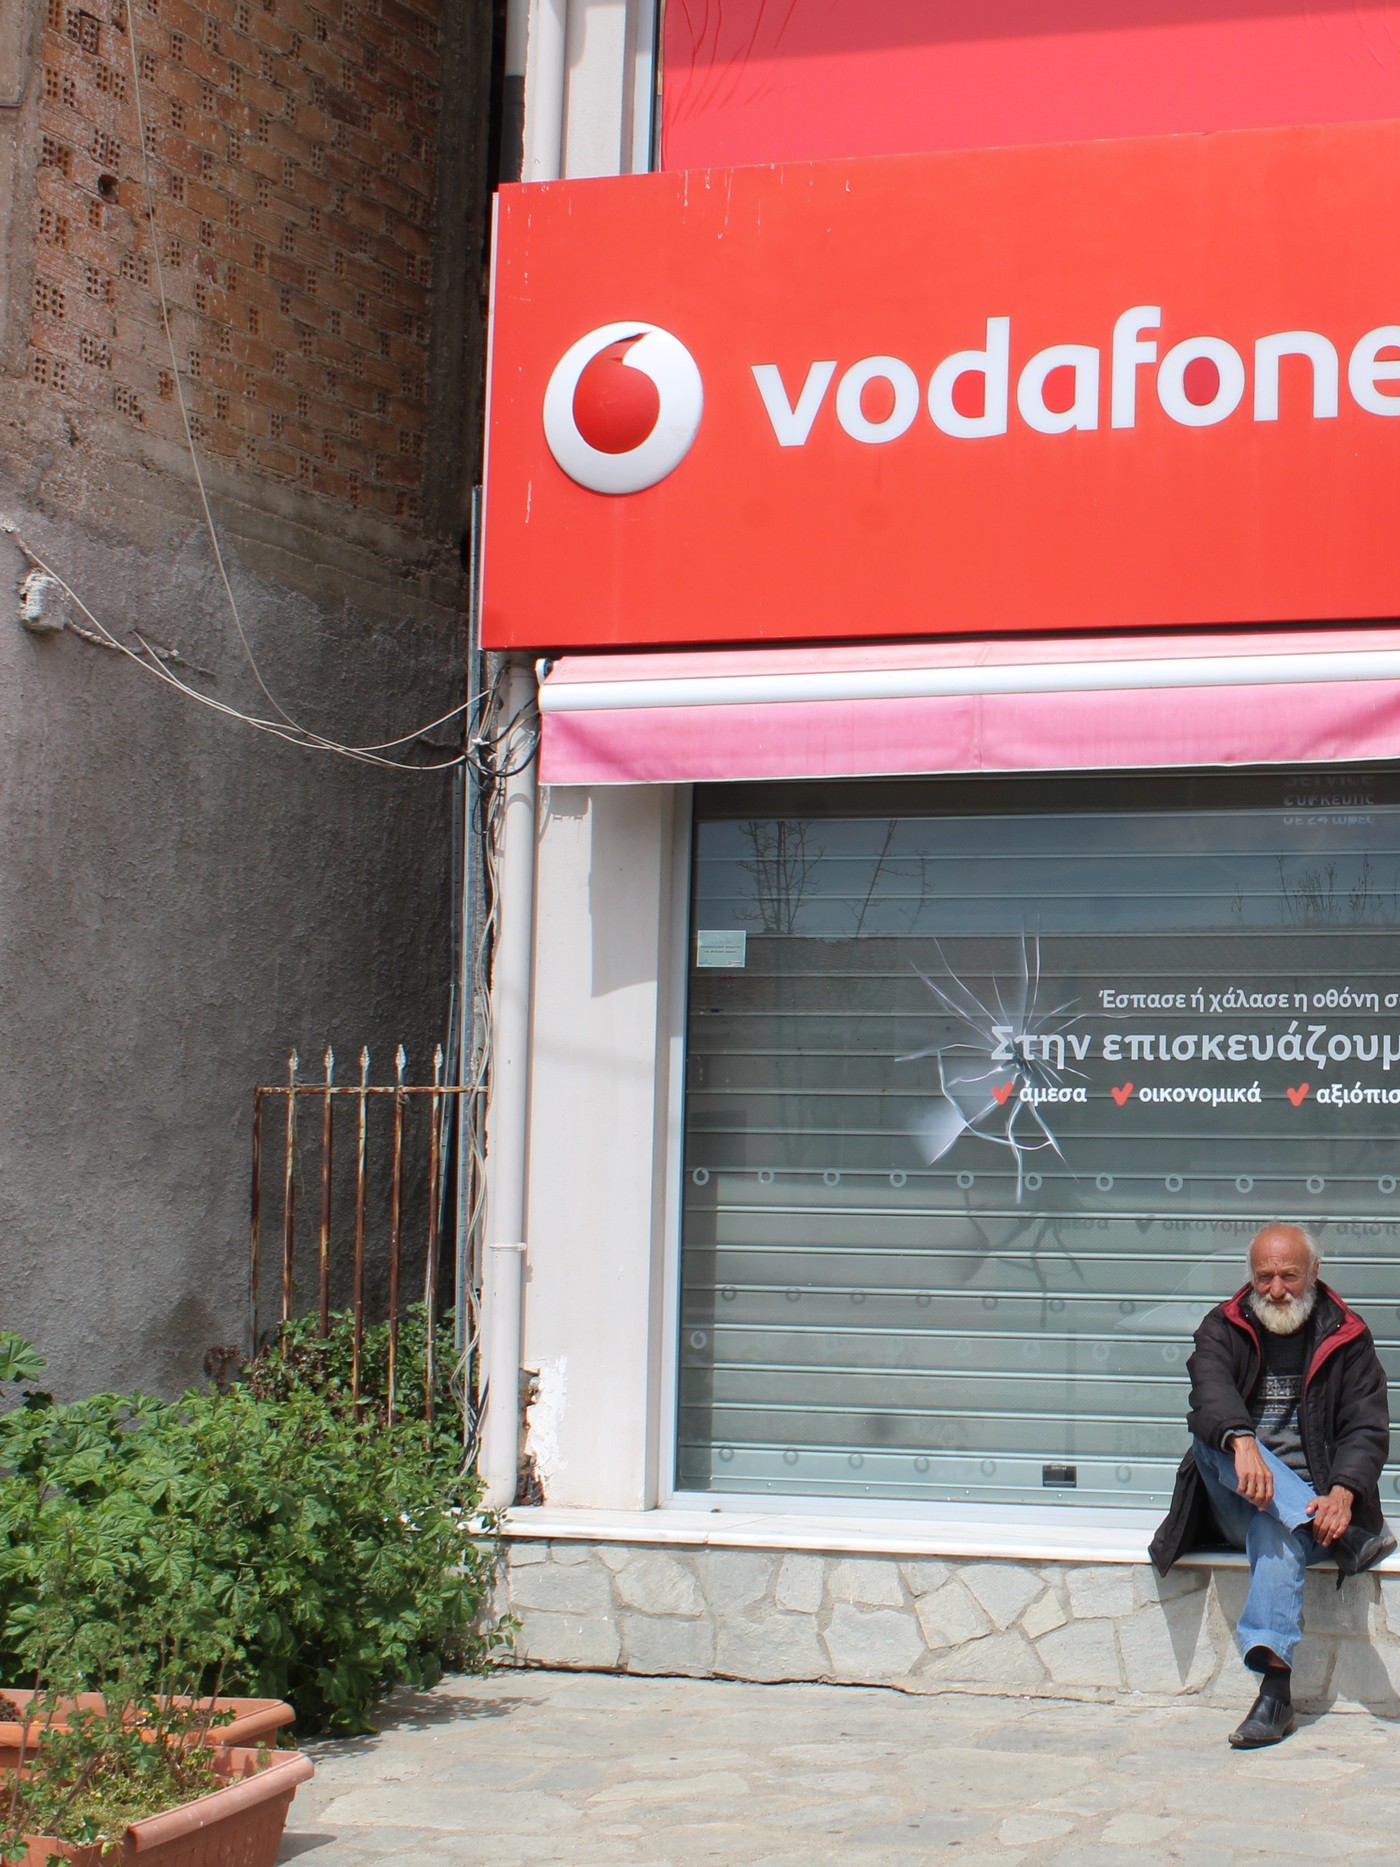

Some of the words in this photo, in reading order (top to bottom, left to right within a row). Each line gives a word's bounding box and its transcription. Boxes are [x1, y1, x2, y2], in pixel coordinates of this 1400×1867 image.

[1099, 989, 1187, 1009] Έσπασε
[1191, 987, 1205, 1013] ή
[1209, 987, 1290, 1013] χάλασε
[1294, 993, 1308, 1013] η
[1312, 987, 1379, 1013] οθόνη
[991, 1025, 1092, 1070] Στην
[1019, 1081, 1088, 1107] άμεσα
[1138, 1081, 1262, 1108] οικονομικά
